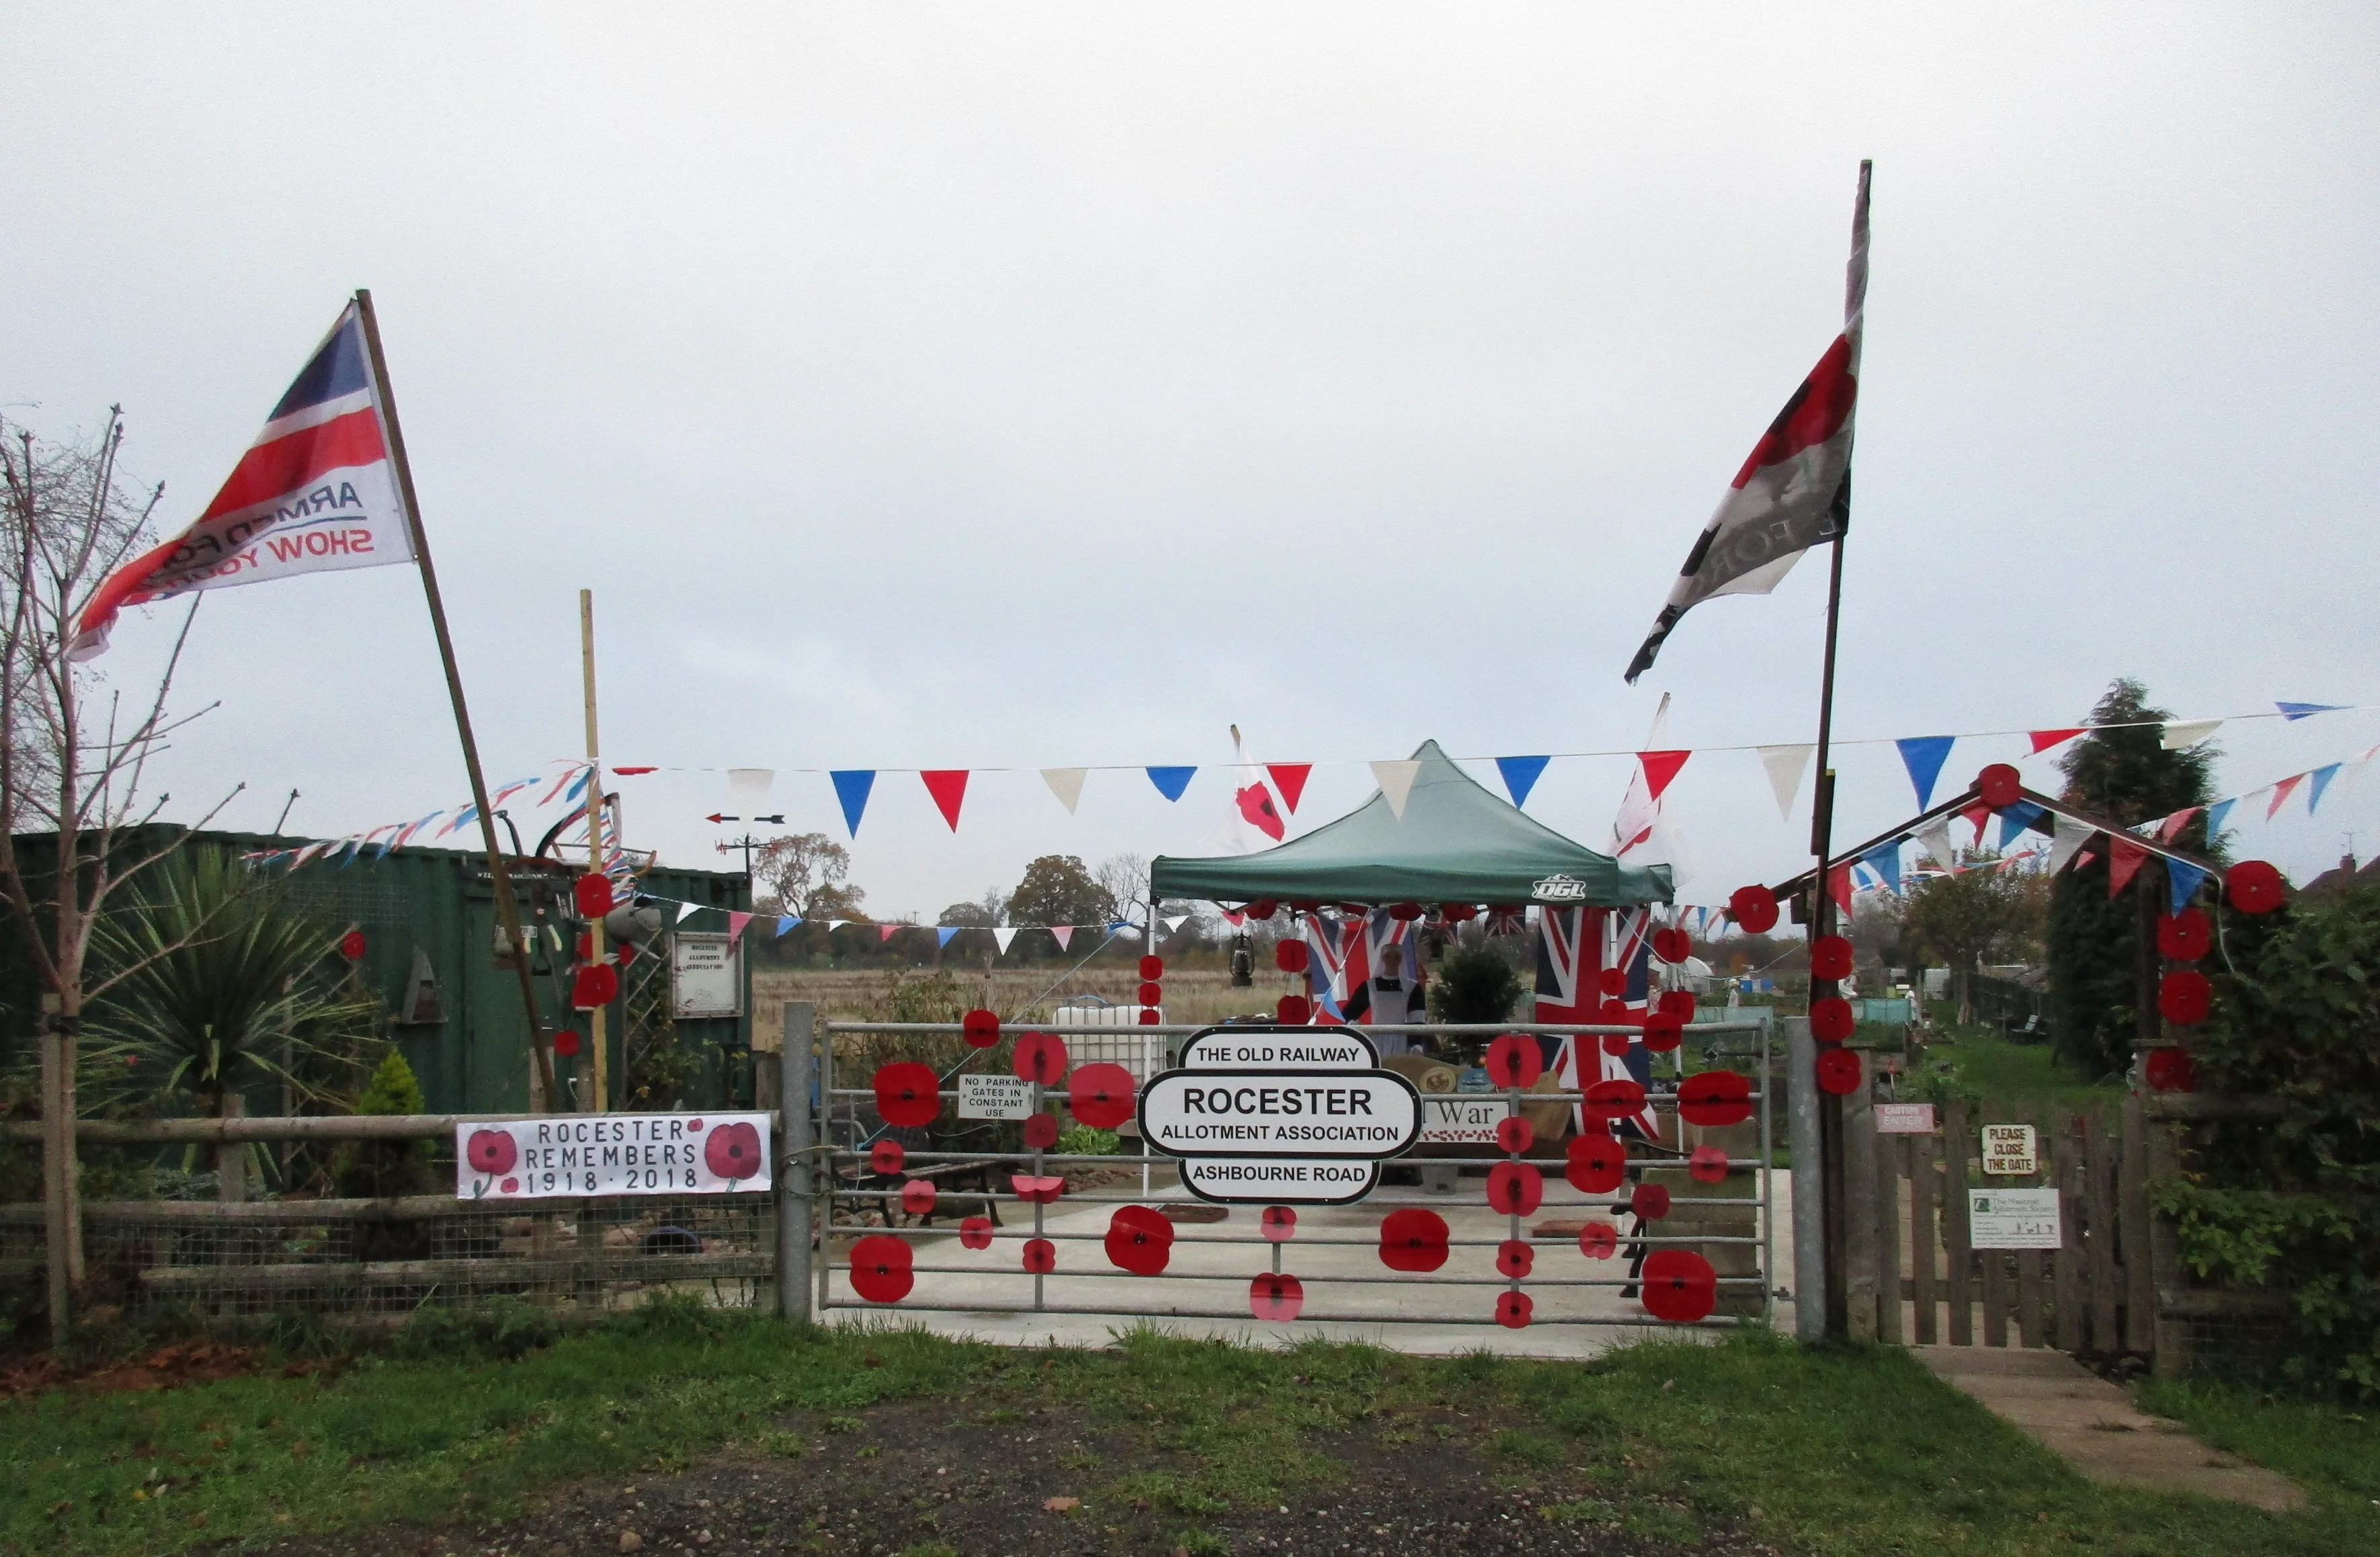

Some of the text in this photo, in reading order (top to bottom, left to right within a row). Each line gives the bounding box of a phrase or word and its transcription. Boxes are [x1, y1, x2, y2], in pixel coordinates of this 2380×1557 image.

[1197, 1048, 1360, 1062] THE OLD RAILWAY
[986, 1079, 1028, 1087] PARKING
[972, 1088, 1004, 1097] GATES
[969, 1098, 1023, 1107] CONSTANT
[1184, 1088, 1372, 1116] ROCESTER
[1438, 1101, 1493, 1124] War
[538, 1120, 683, 1144] ROCESTER
[1161, 1125, 1399, 1140] ALLOTMENT ASSOCIATION
[1989, 1128, 2026, 1140] PLEASE
[526, 1144, 695, 1169] REMEMBERS
[1994, 1144, 2024, 1155] CLOSE
[1987, 1159, 2032, 1170] THE GATE
[528, 1171, 597, 1193] 1918
[626, 1168, 696, 1189] 2018
[1193, 1167, 1366, 1181] ASHBOURNE ROAD
